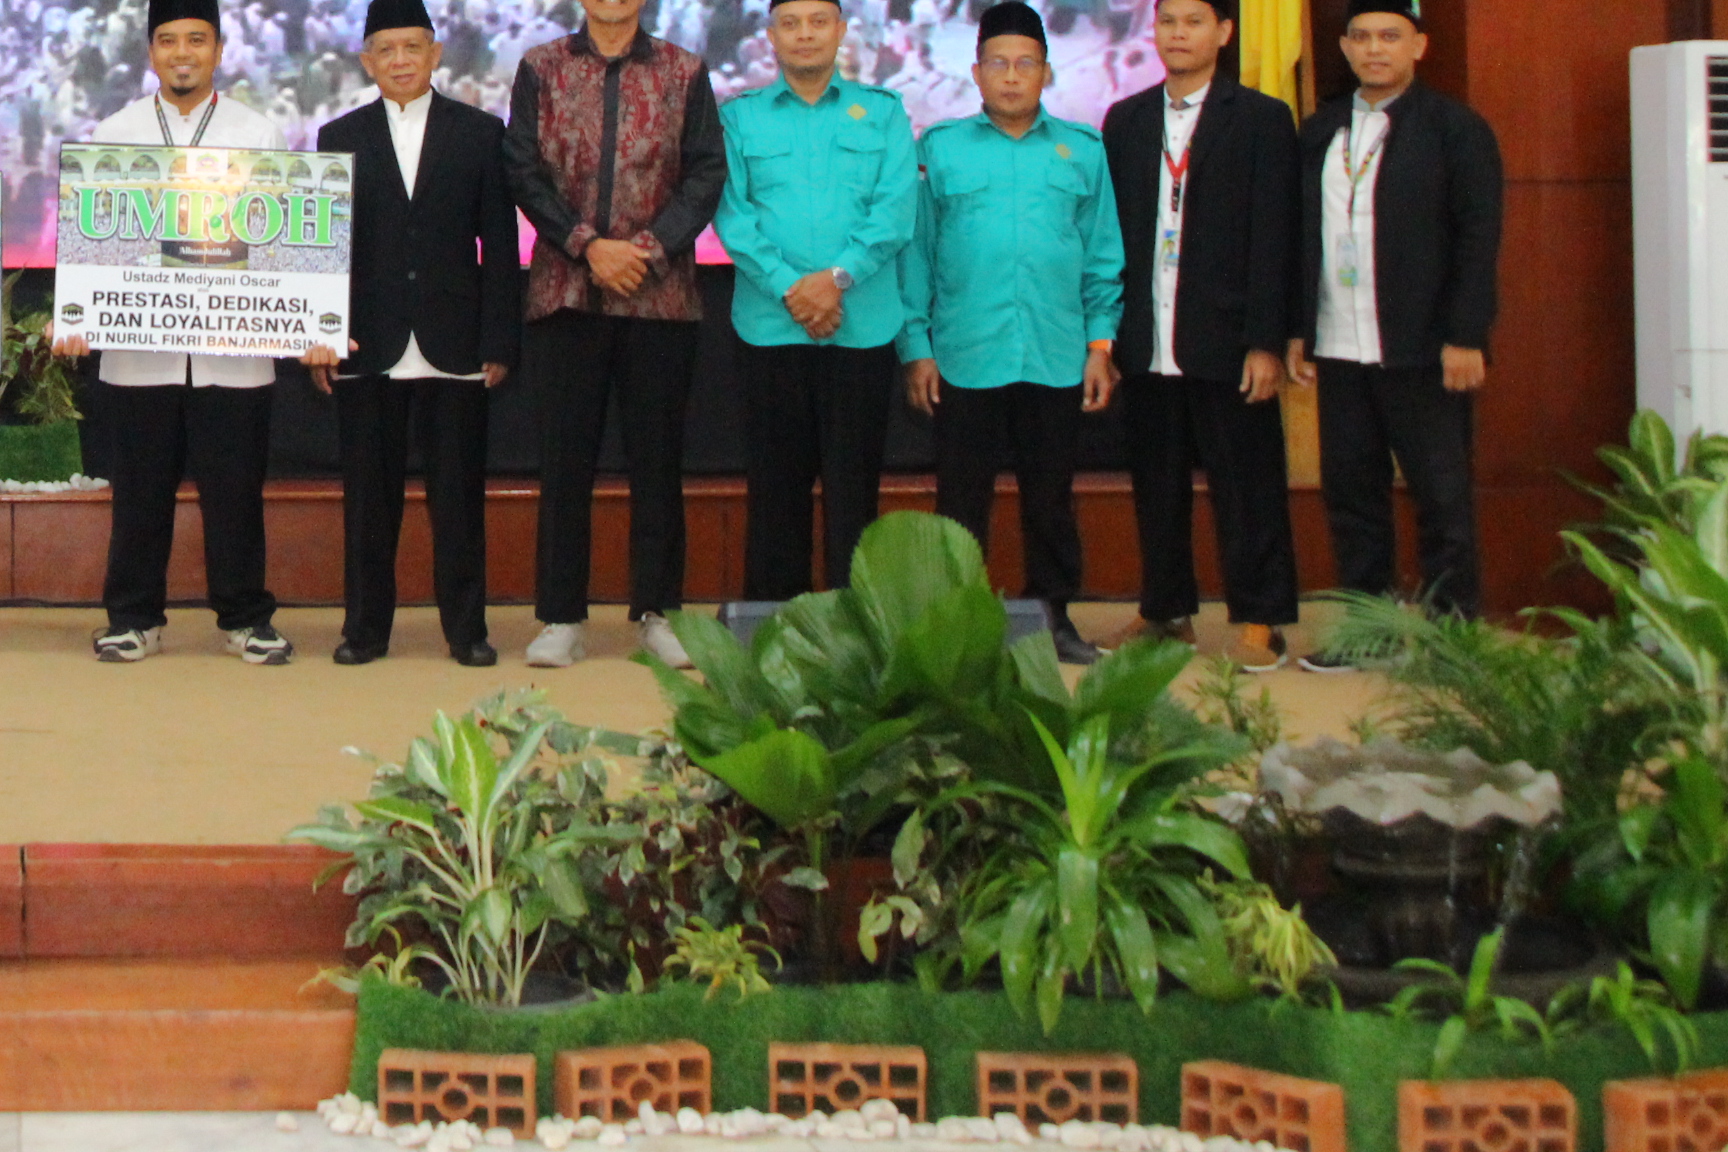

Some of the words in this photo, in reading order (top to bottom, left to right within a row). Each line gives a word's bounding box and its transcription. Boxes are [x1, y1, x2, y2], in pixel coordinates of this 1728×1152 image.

[74, 186, 338, 247] UMROH
[123, 270, 170, 283] Ustadz
[174, 272, 236, 288] Mediyani
[240, 274, 281, 288] Oscar
[92, 291, 200, 312] PRESTASI,
[208, 294, 314, 317] DEDIKASI,
[99, 312, 142, 328] DAN
[151, 313, 306, 334] LOYALITASNYA
[86, 332, 100, 342] DI
[106, 332, 157, 345] NURUL
[162, 334, 201, 346] FIKRI
